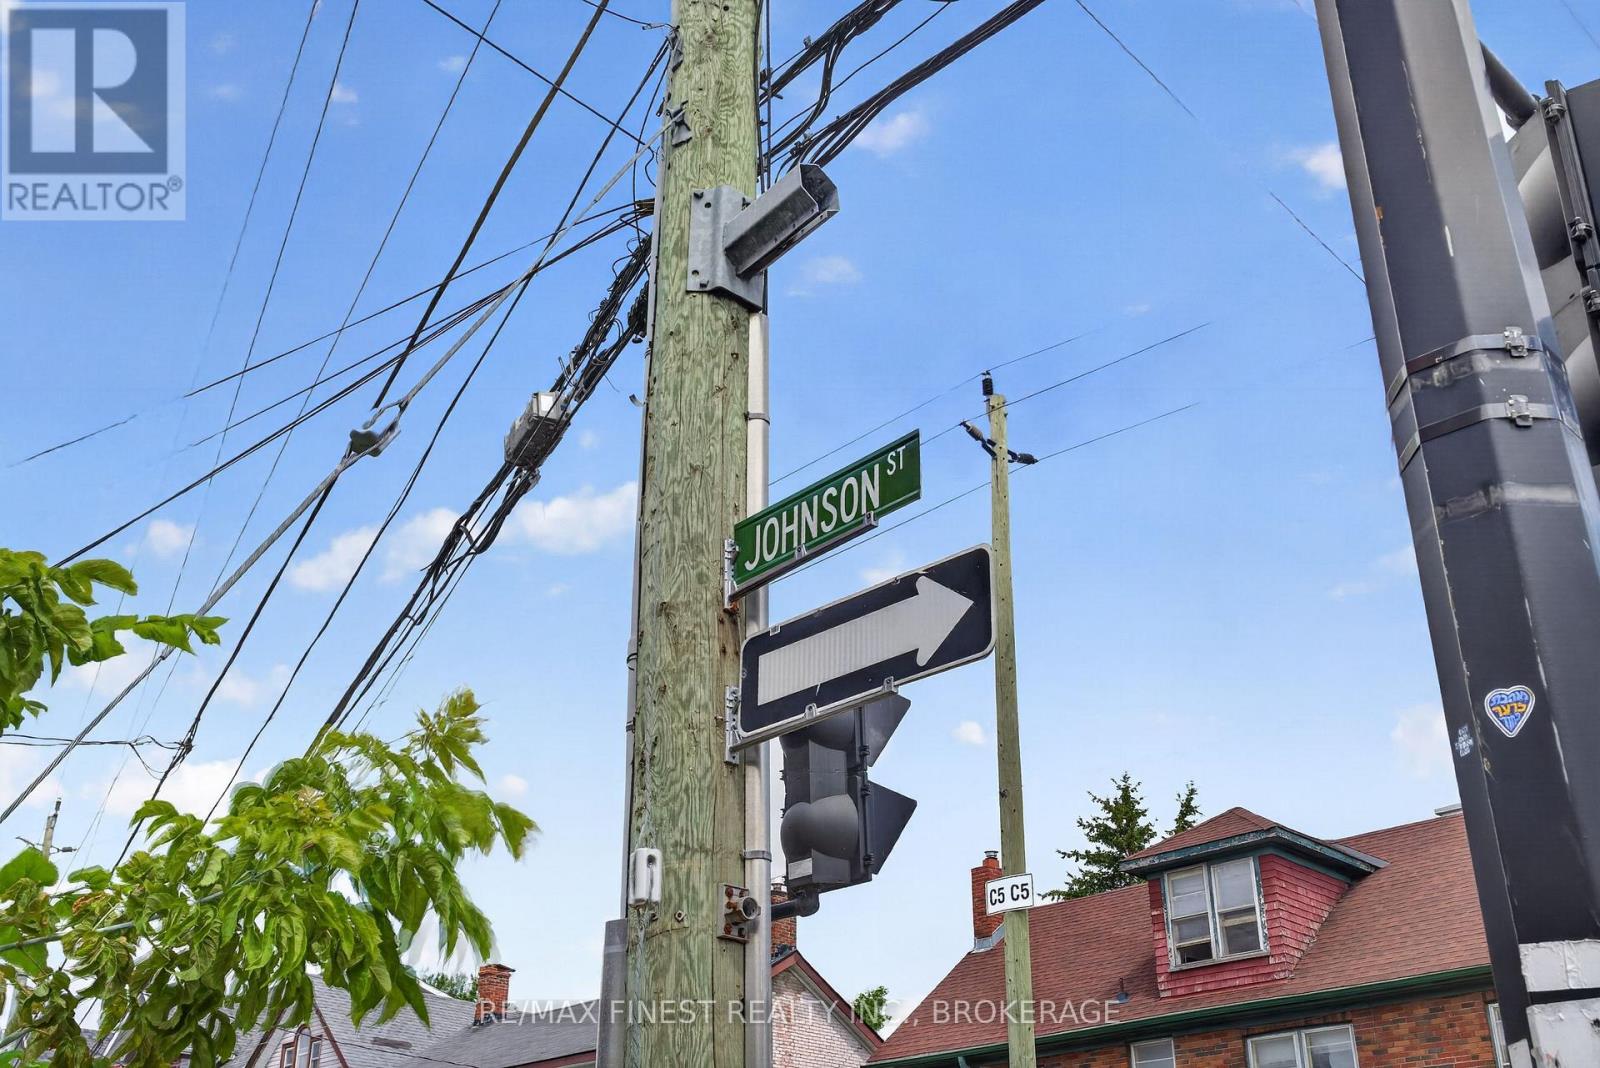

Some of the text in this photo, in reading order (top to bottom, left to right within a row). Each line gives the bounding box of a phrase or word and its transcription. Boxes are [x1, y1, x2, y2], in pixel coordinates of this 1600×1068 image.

[745, 446, 906, 571] JOHNSON ST
[990, 883, 1030, 906] C5 C5
